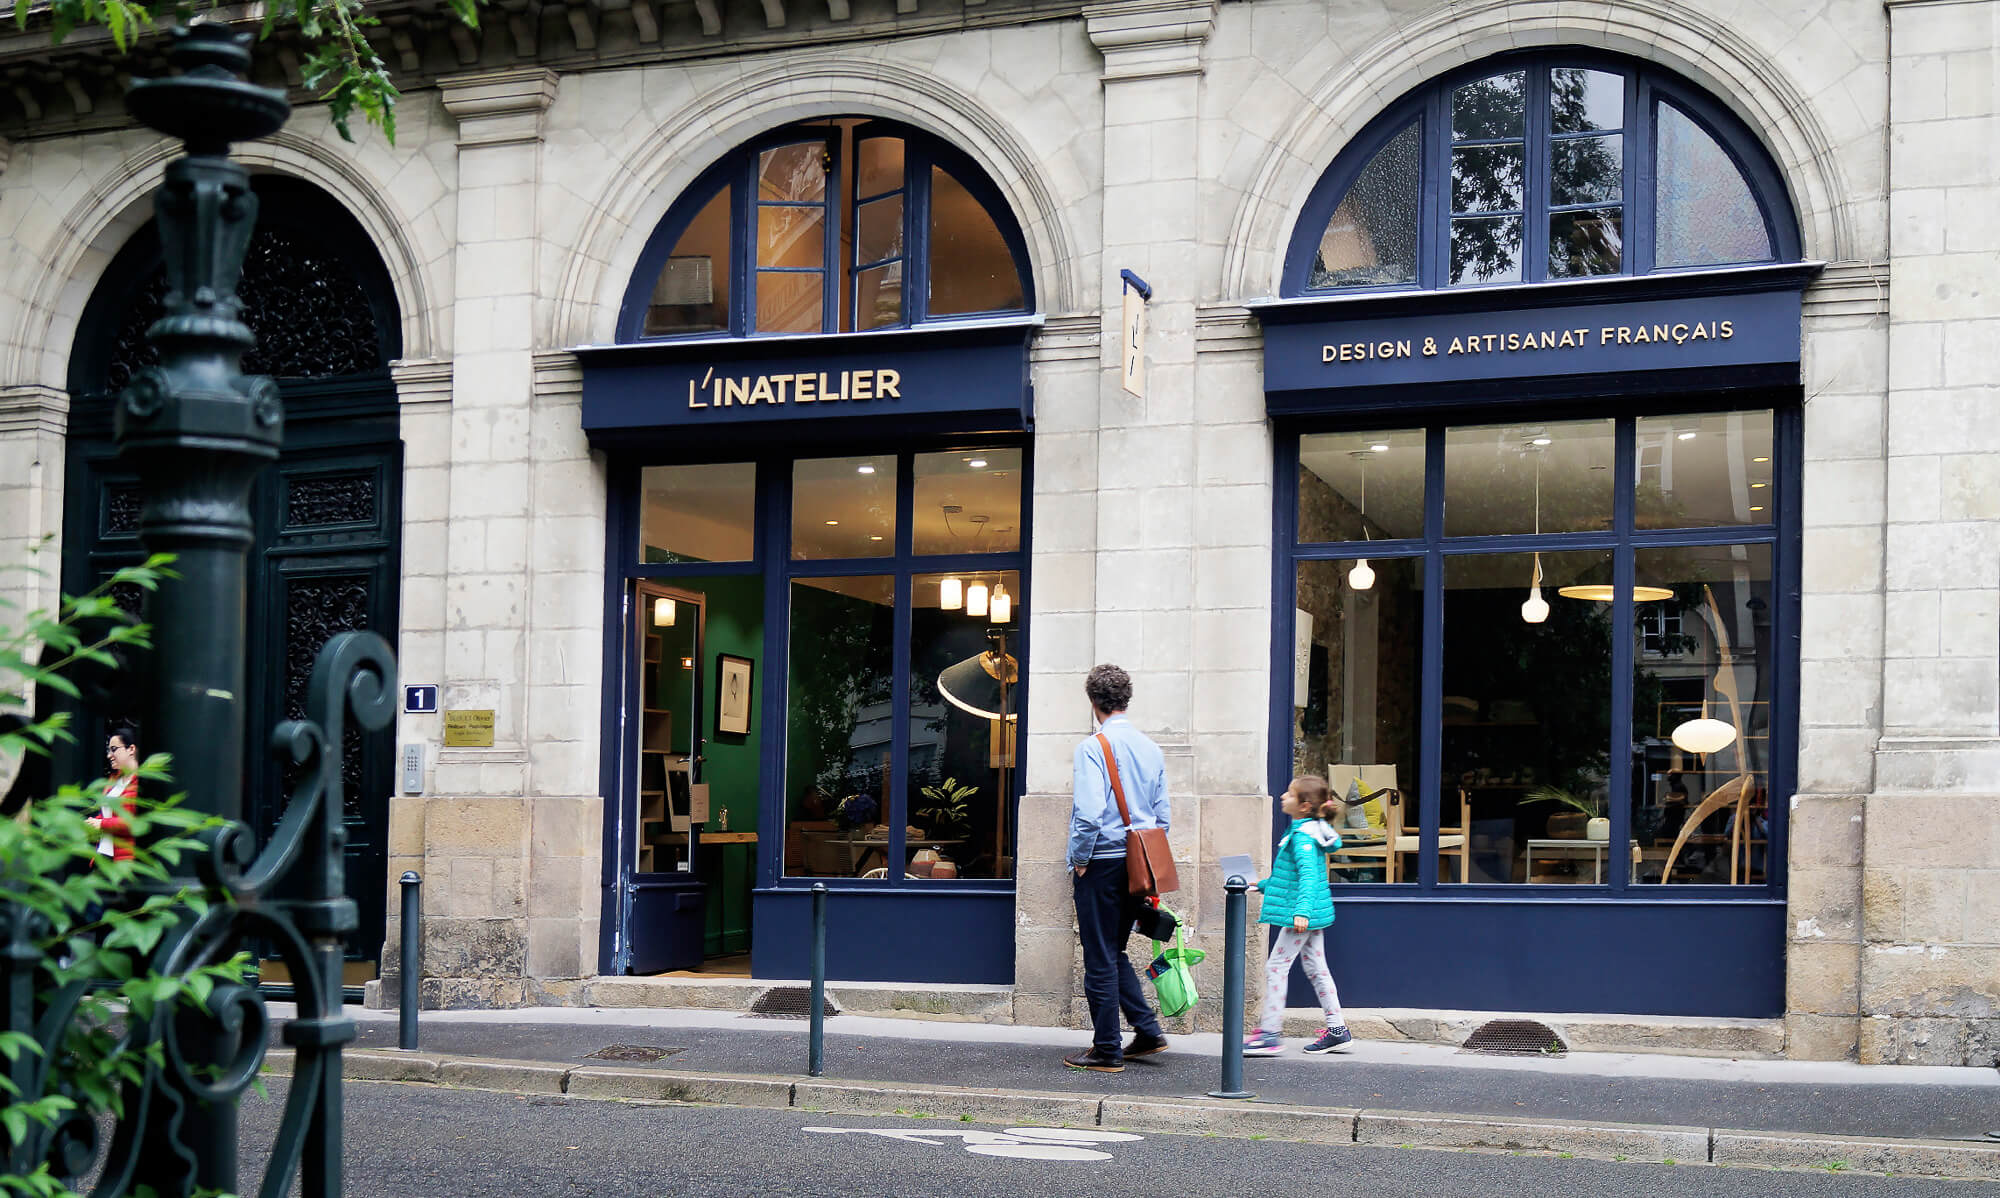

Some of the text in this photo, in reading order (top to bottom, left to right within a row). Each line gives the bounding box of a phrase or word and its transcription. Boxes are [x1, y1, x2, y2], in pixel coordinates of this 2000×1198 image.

[1322, 320, 1734, 362] DESIGN & ARTISANAT FRANÇAIS
[688, 366, 901, 408] L'INATELIER
[414, 688, 424, 709] 1
